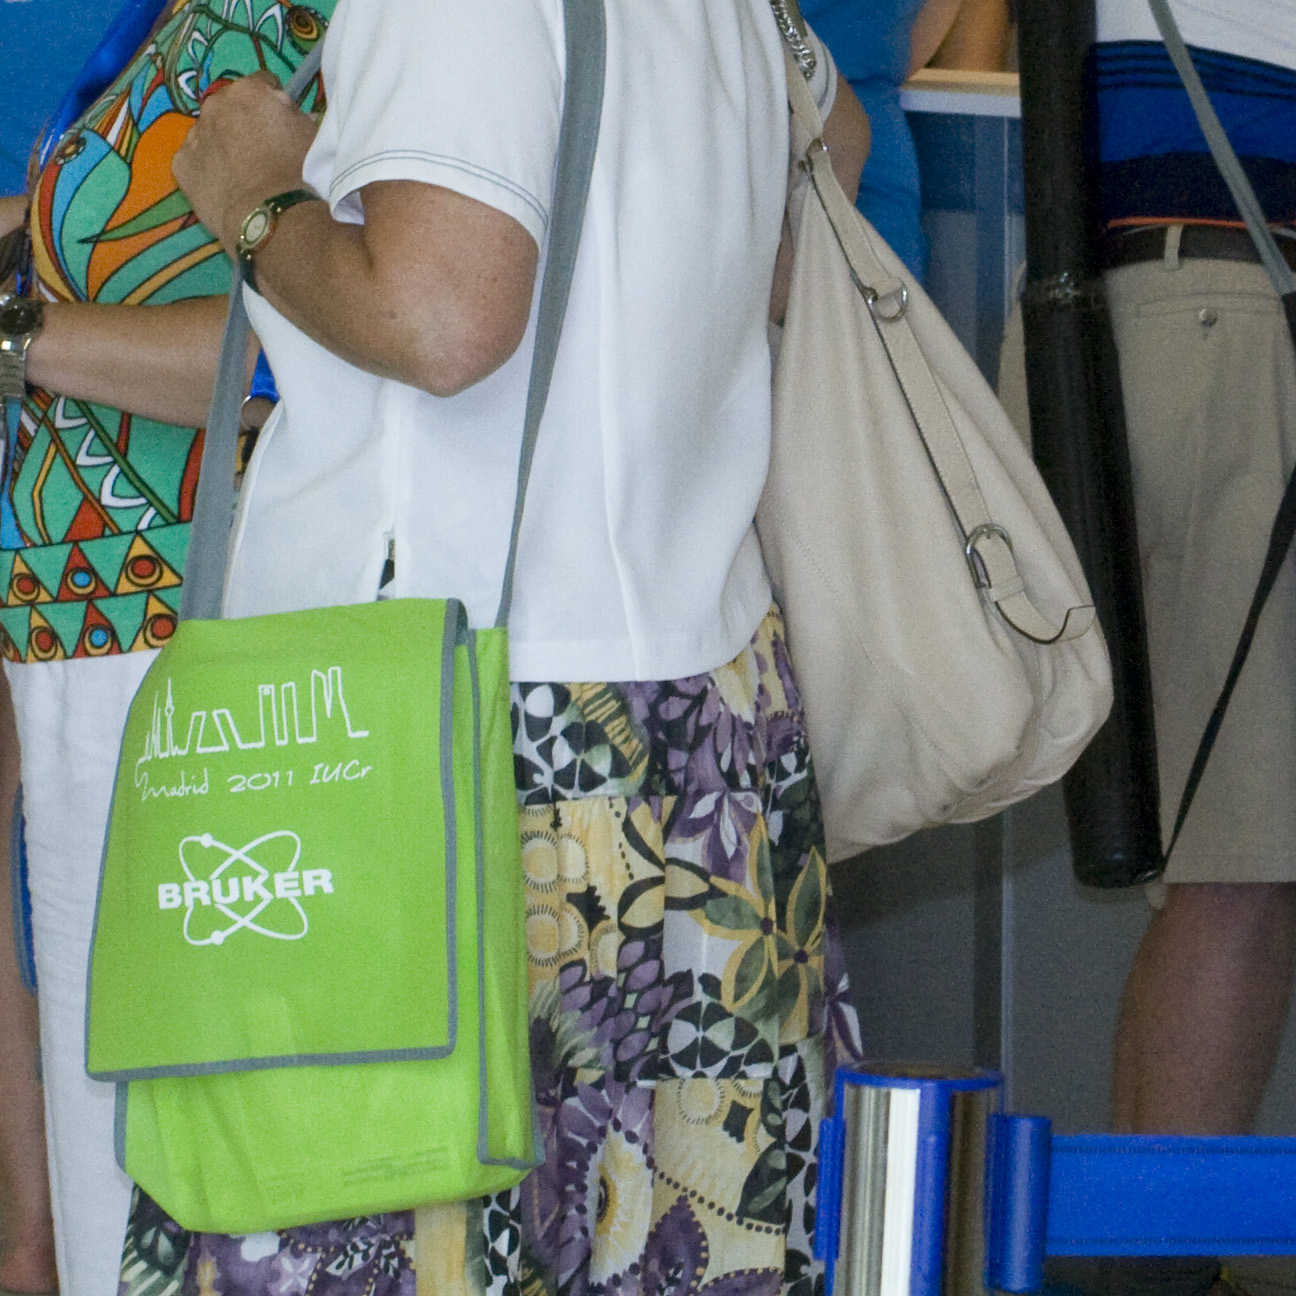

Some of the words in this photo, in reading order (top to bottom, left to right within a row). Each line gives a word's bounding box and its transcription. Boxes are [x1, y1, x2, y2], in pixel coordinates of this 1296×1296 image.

[227, 770, 293, 793] 2011
[310, 759, 373, 785] IUCr
[157, 868, 335, 910] BRUKER
